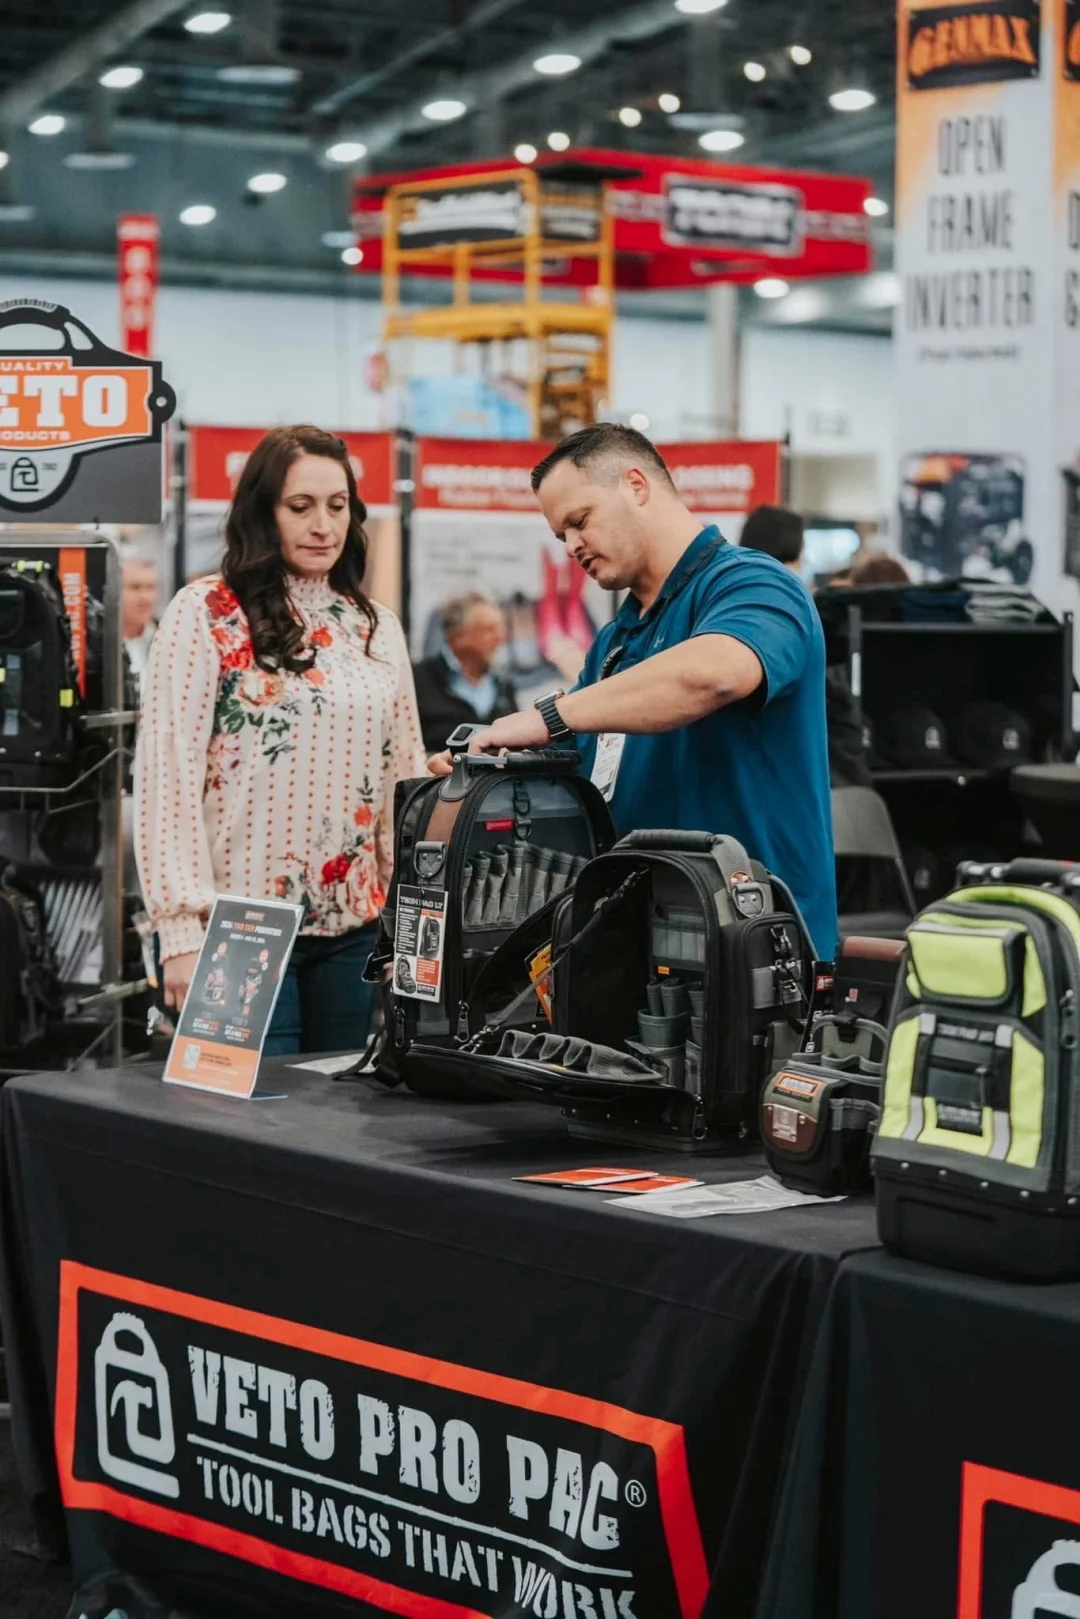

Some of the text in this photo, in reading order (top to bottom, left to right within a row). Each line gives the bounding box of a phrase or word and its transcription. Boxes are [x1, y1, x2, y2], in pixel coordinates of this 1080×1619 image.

[938, 115, 1005, 176] OPEN
[927, 190, 1012, 253] FRAME
[905, 267, 1034, 330] INVERTER
[0, 431, 70, 440] ODUCTS
[188, 1345, 335, 1460] VETO
[357, 1393, 480, 1504] PRO
[197, 1456, 636, 1619] TOOL BAGS THAT WORK
